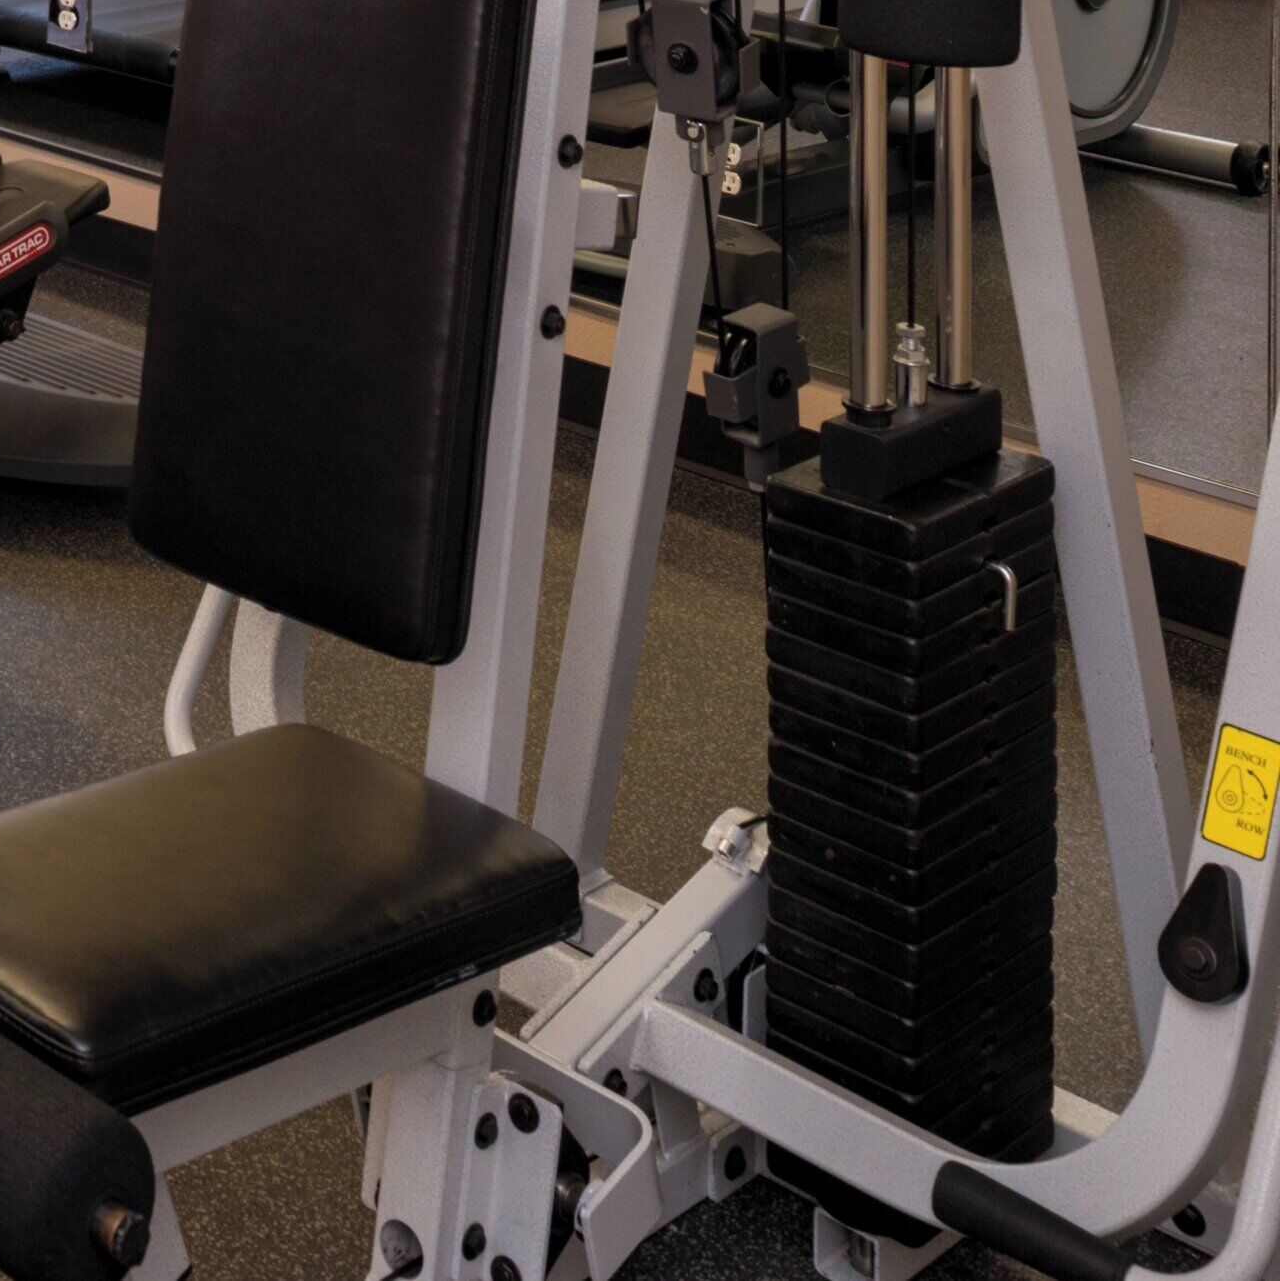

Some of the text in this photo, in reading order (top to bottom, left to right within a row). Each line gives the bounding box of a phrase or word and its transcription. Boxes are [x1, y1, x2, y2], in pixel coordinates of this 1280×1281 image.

[11, 232, 44, 259] TRAC
[1225, 744, 1268, 769] BENCH
[1235, 818, 1265, 837] ROW
